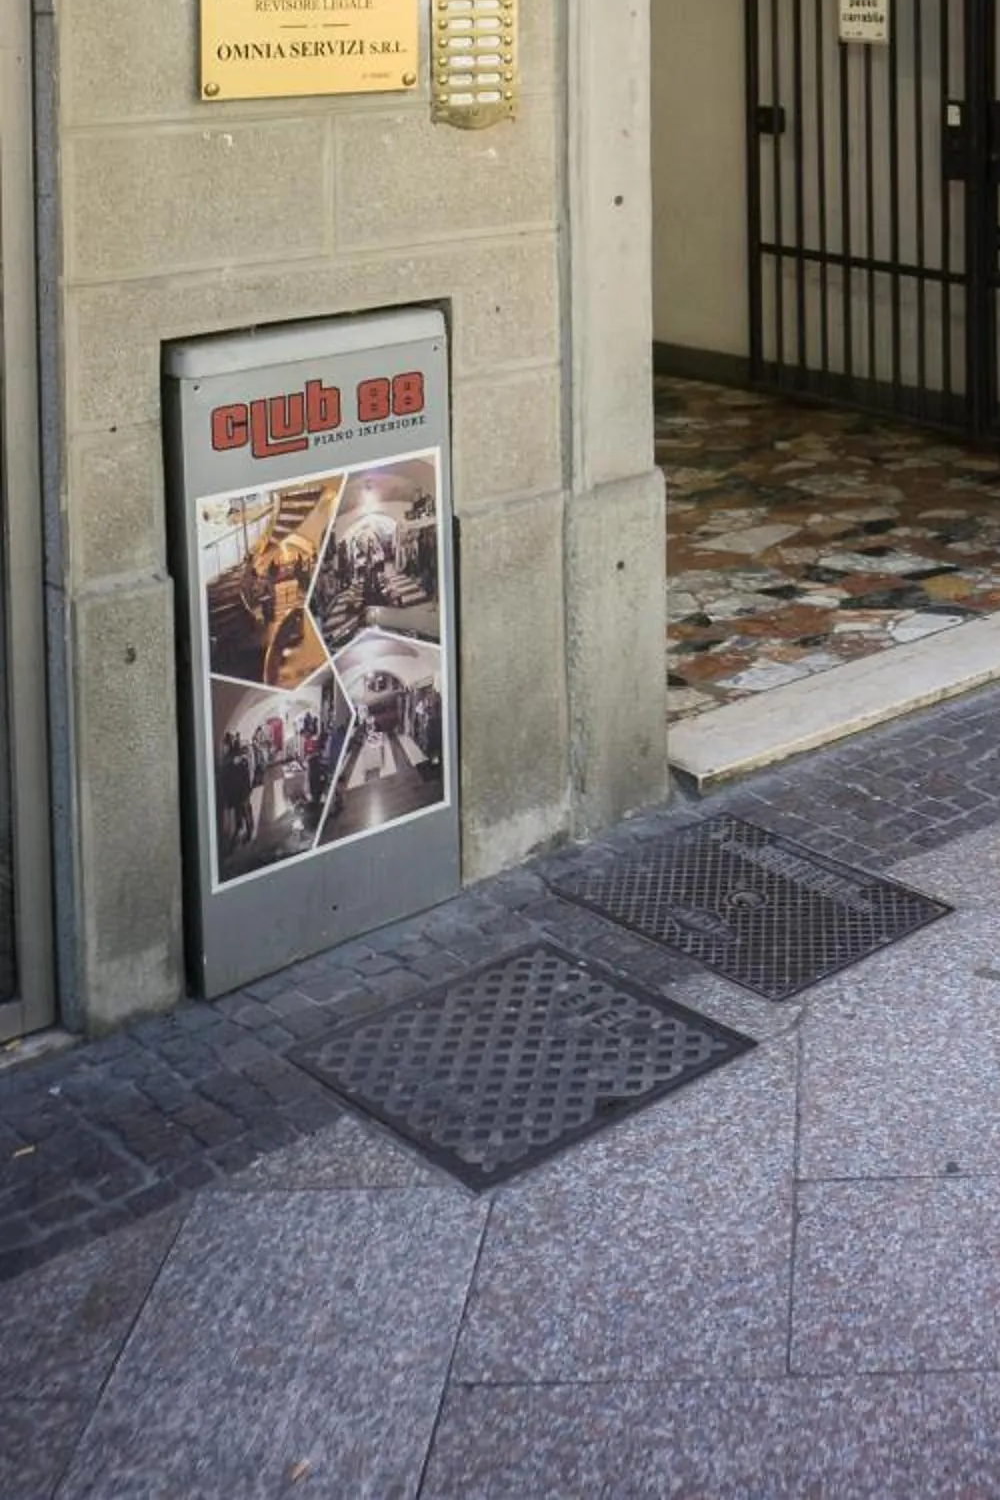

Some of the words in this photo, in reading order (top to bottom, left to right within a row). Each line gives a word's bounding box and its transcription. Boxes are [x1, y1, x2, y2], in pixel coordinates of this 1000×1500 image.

[216, 42, 287, 62] OMNIA
[288, 39, 365, 59] SERVIZI
[356, 371, 425, 423] 88
[313, 429, 353, 448] PIANO
[357, 415, 427, 438] INFERIORE
